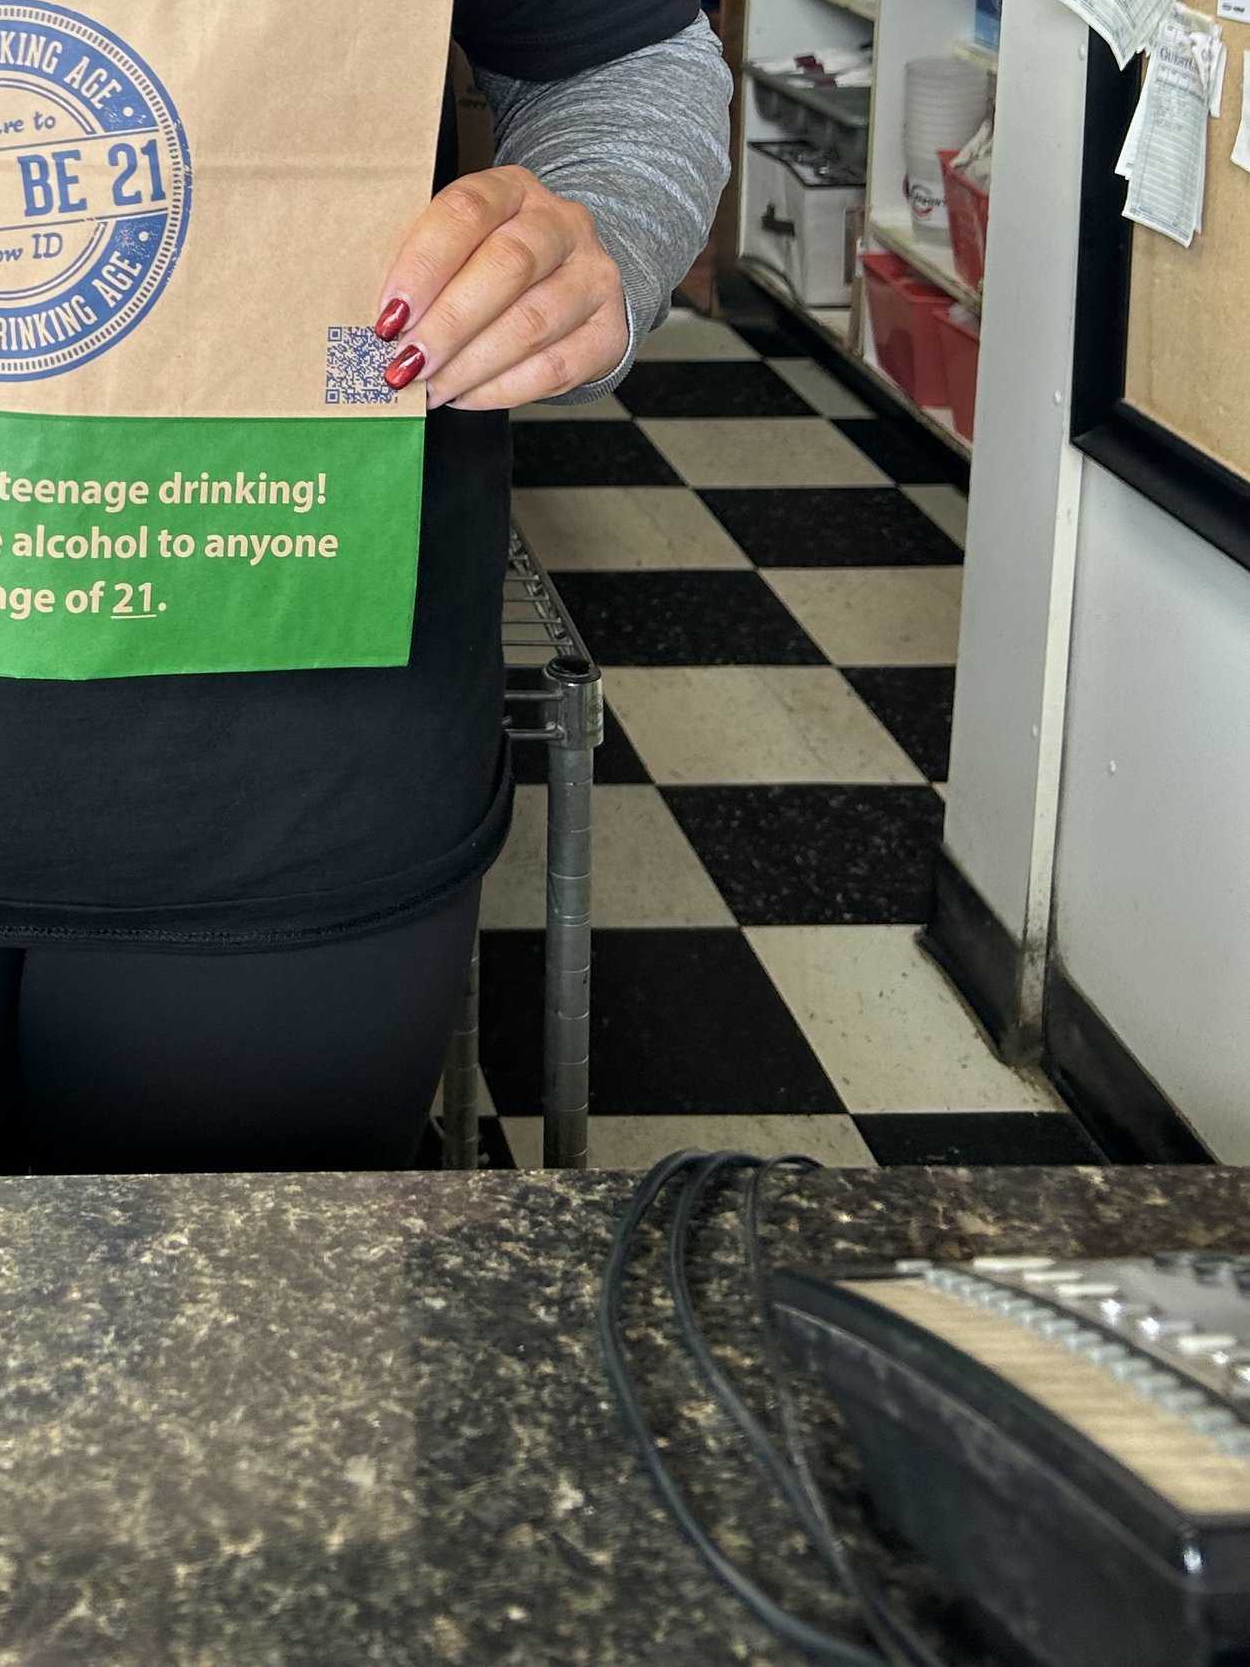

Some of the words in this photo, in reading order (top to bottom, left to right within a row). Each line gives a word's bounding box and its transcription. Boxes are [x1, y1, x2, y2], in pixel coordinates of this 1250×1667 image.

[64, 56, 123, 110] AGE
[34, 111, 56, 130] to
[17, 149, 88, 218] BE
[108, 139, 167, 207] 21
[32, 233, 63, 259] ID
[92, 251, 143, 309] AGE
[158, 471, 327, 513] drinking!
[12, 524, 148, 559] alcohol
[158, 529, 196, 559] to
[204, 532, 339, 566] anyone
[64, 580, 106, 614] of
[111, 582, 167, 619] 21.
